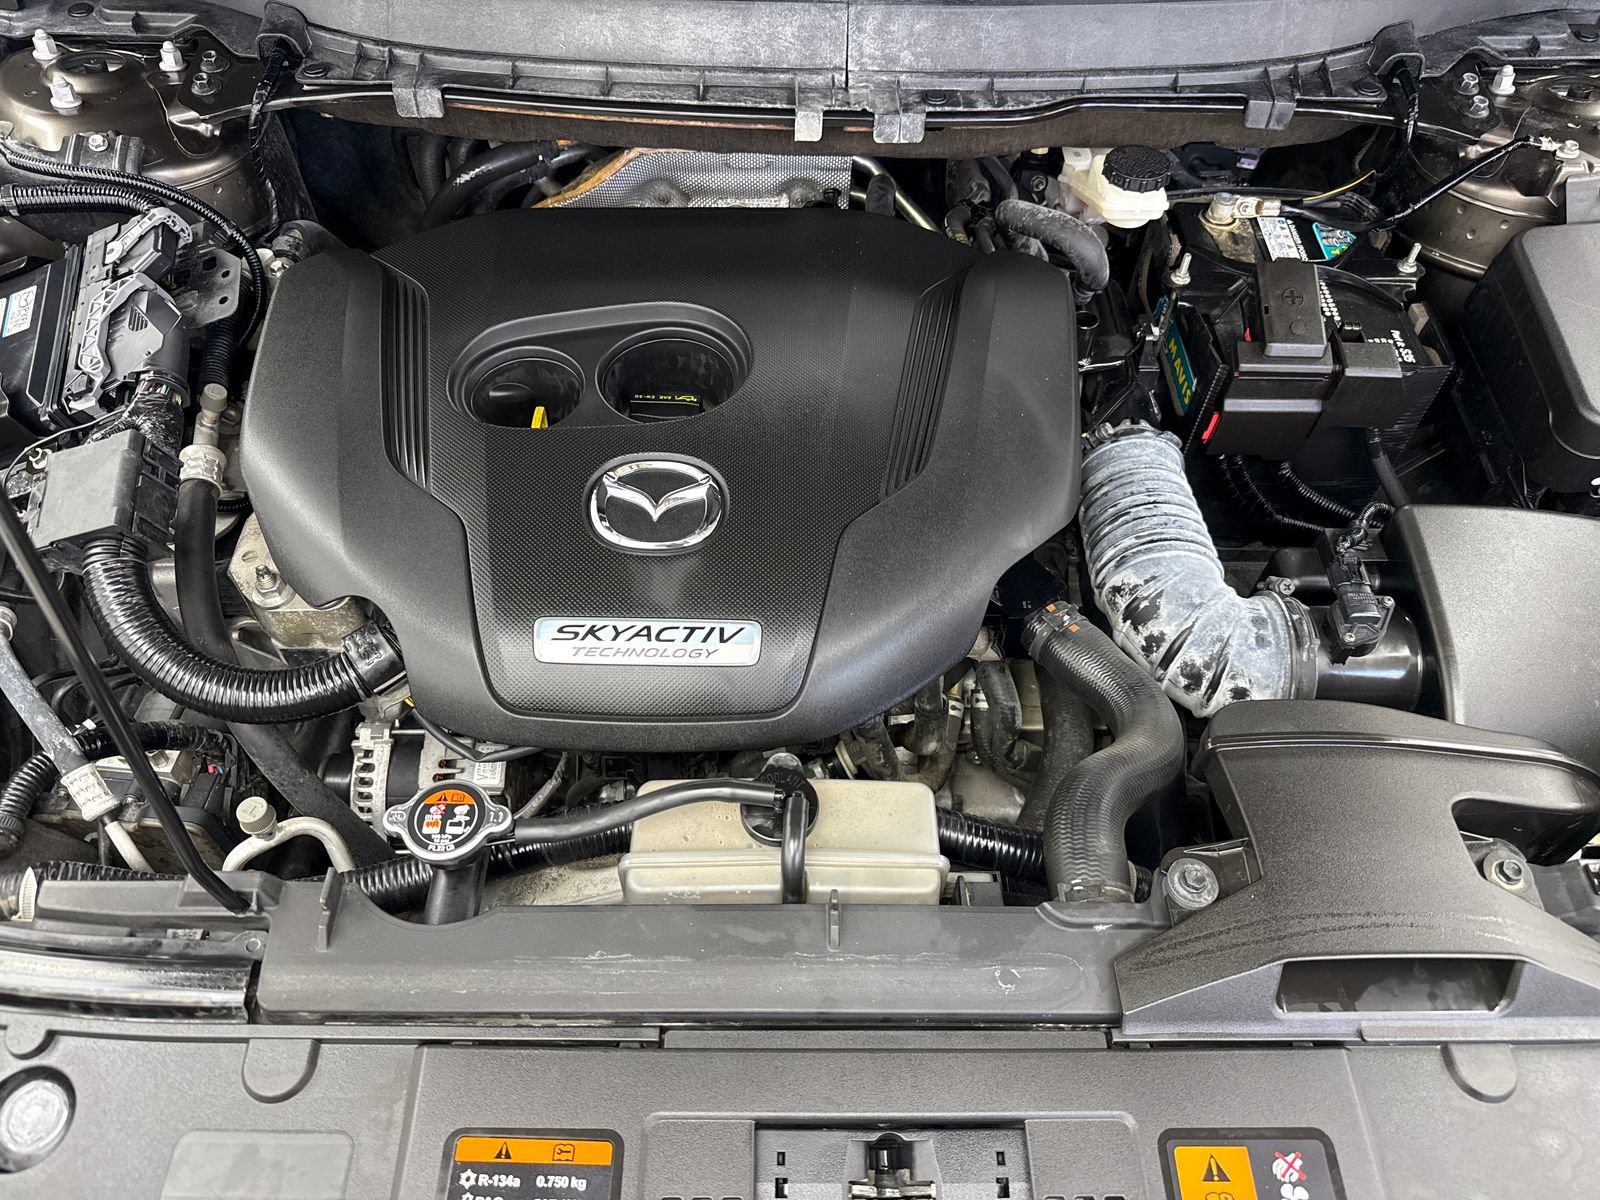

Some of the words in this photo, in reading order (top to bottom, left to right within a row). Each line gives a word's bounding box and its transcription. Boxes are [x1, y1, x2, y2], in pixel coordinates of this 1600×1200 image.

[1169, 337, 1192, 404] MAVIS
[551, 624, 746, 644] SKYACTIV
[572, 646, 720, 659] TECHNOLOGY
[478, 1174, 520, 1188] R-134a
[536, 1174, 570, 1188] 0.750
[570, 1176, 587, 1191] kg
